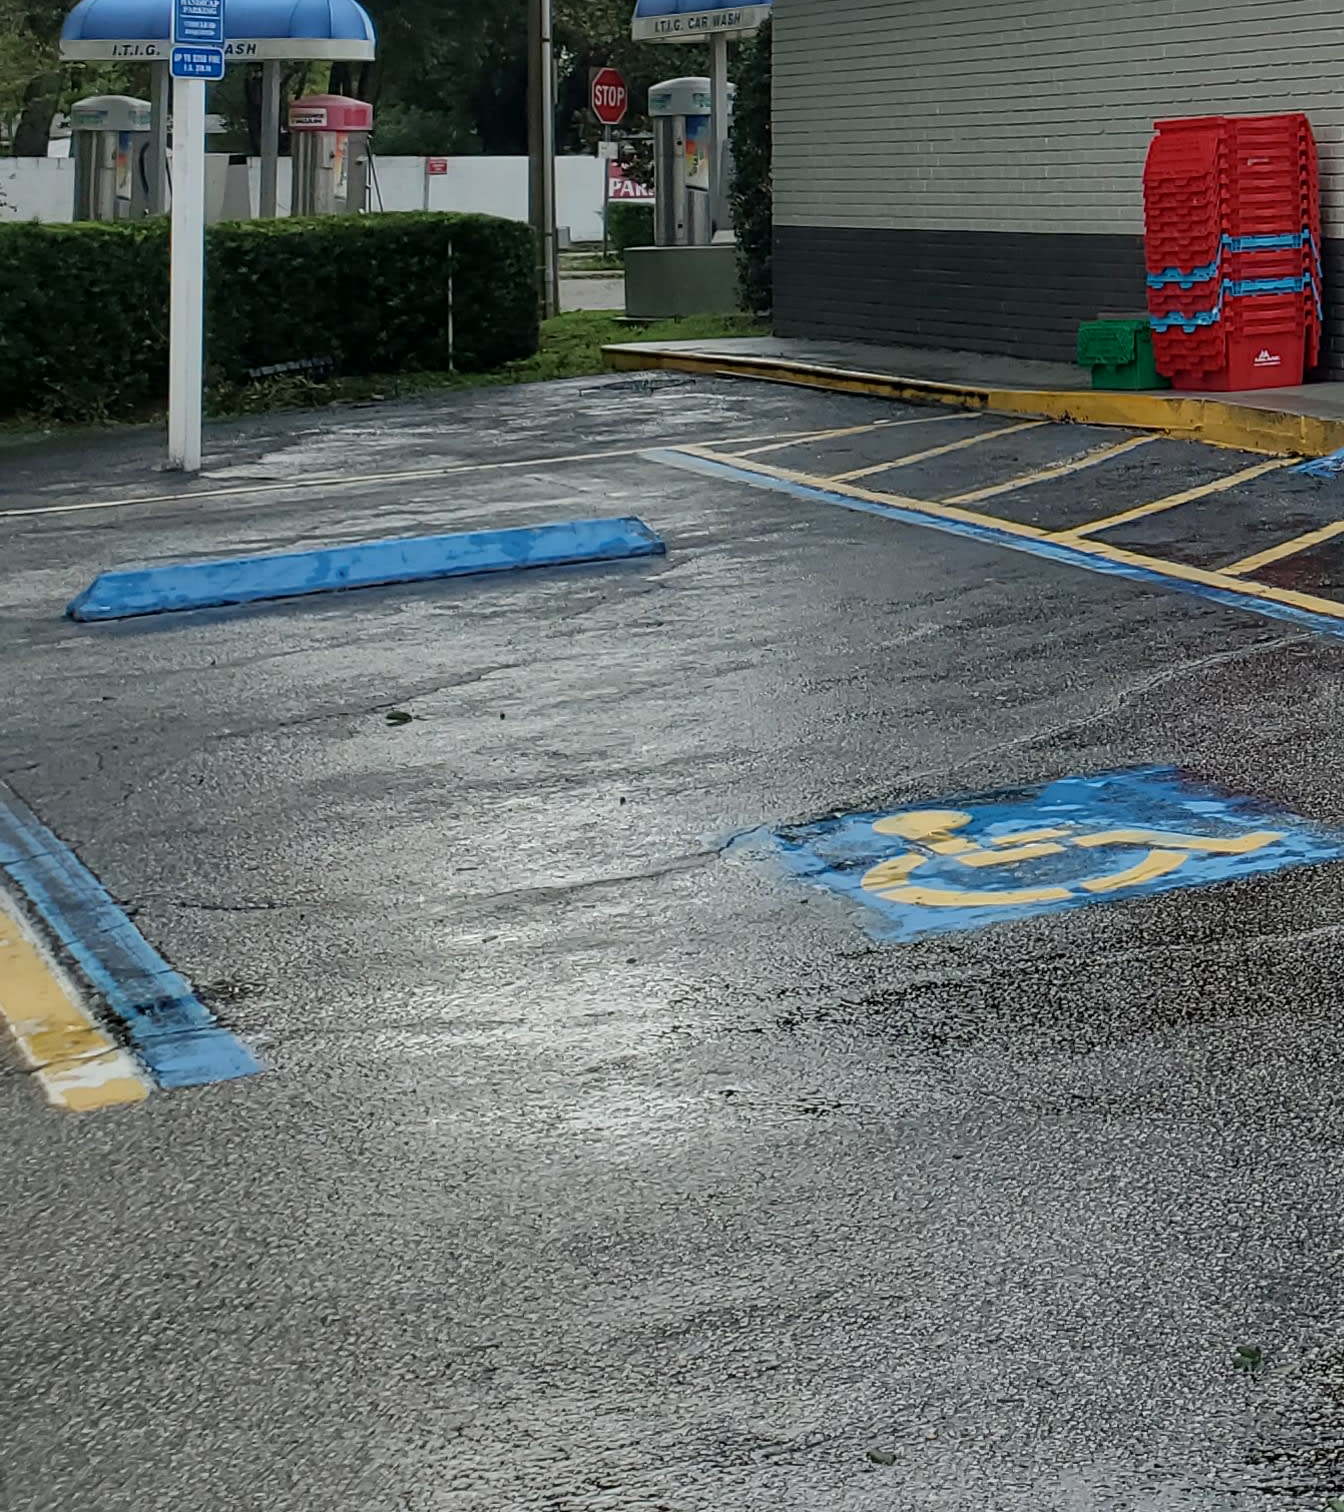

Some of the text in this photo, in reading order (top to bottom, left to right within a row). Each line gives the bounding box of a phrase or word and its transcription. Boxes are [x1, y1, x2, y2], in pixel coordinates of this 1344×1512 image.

[654, 12, 741, 34] I.T.I.G. CAR WASH
[111, 43, 257, 56] I.T.I.G. ASH
[594, 86, 625, 107] STOP
